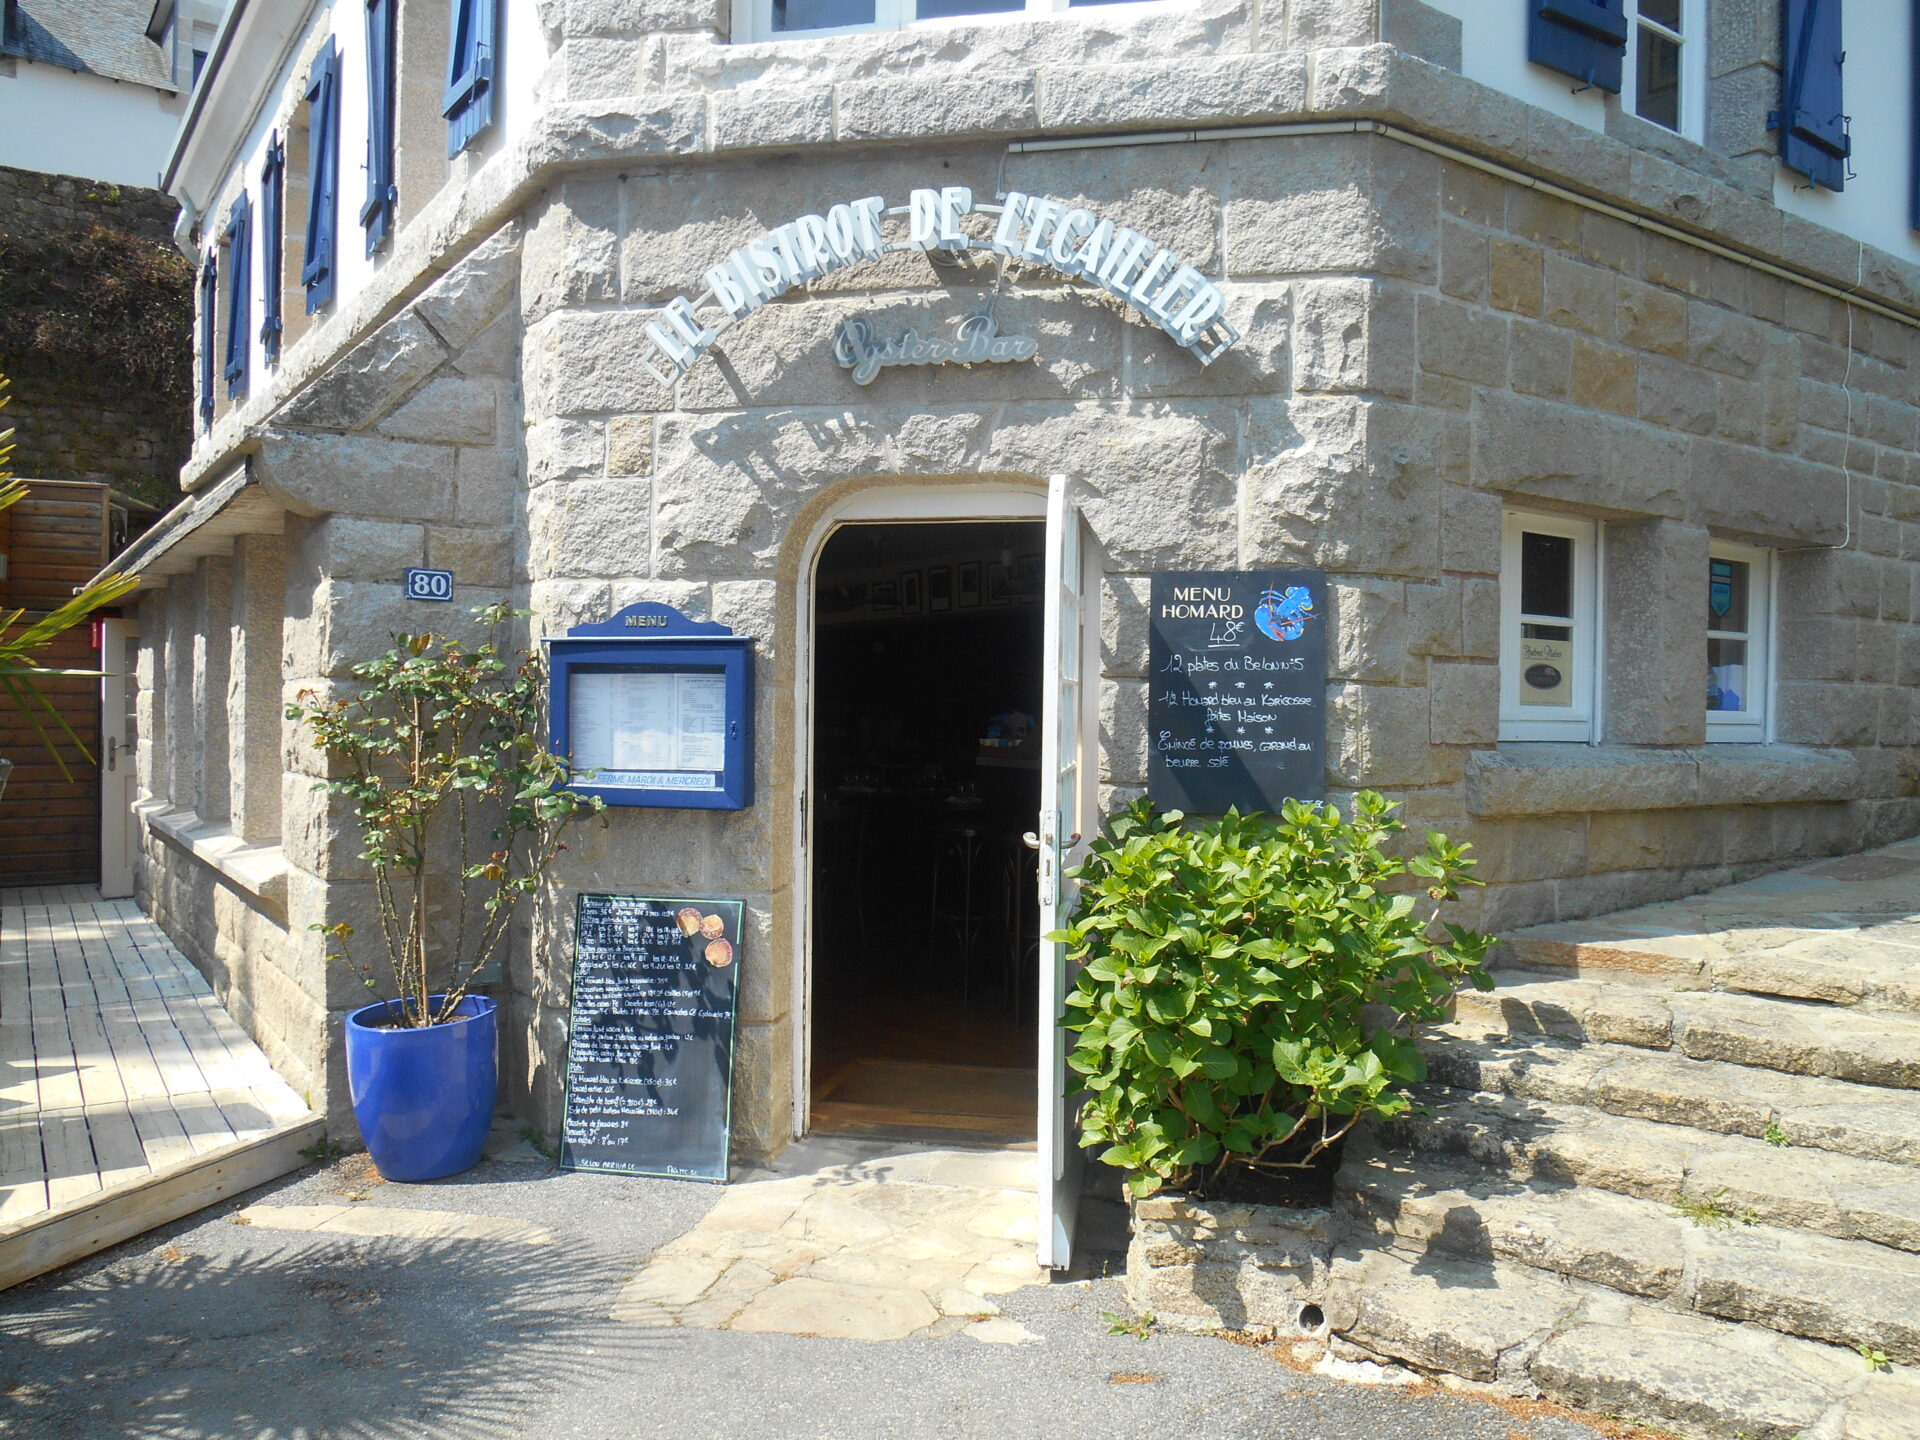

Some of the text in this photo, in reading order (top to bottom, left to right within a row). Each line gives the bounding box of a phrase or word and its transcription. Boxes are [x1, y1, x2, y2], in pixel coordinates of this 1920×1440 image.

[645, 295, 707, 362] LE
[705, 194, 886, 313] BISTROT
[909, 186, 971, 247] DE
[835, 314, 1034, 380] Oyster Bar
[414, 574, 447, 596] 80
[1173, 587, 1231, 601] MENU
[1161, 604, 1244, 619] HOMARD
[625, 615, 668, 628] MENU
[1208, 621, 1245, 643] 48€
[1160, 654, 1183, 673] 12
[1187, 655, 1220, 677] plates
[1224, 657, 1240, 671] du
[1221, 693, 1242, 706] bleu
[1243, 696, 1257, 706] au
[1200, 737, 1215, 750] de
[1298, 741, 1312, 751] au
[1207, 755, 1230, 768] salé
[626, 775, 657, 785] MARDI
[656, 776, 665, 785] &
[665, 776, 711, 786] MERCREDI
